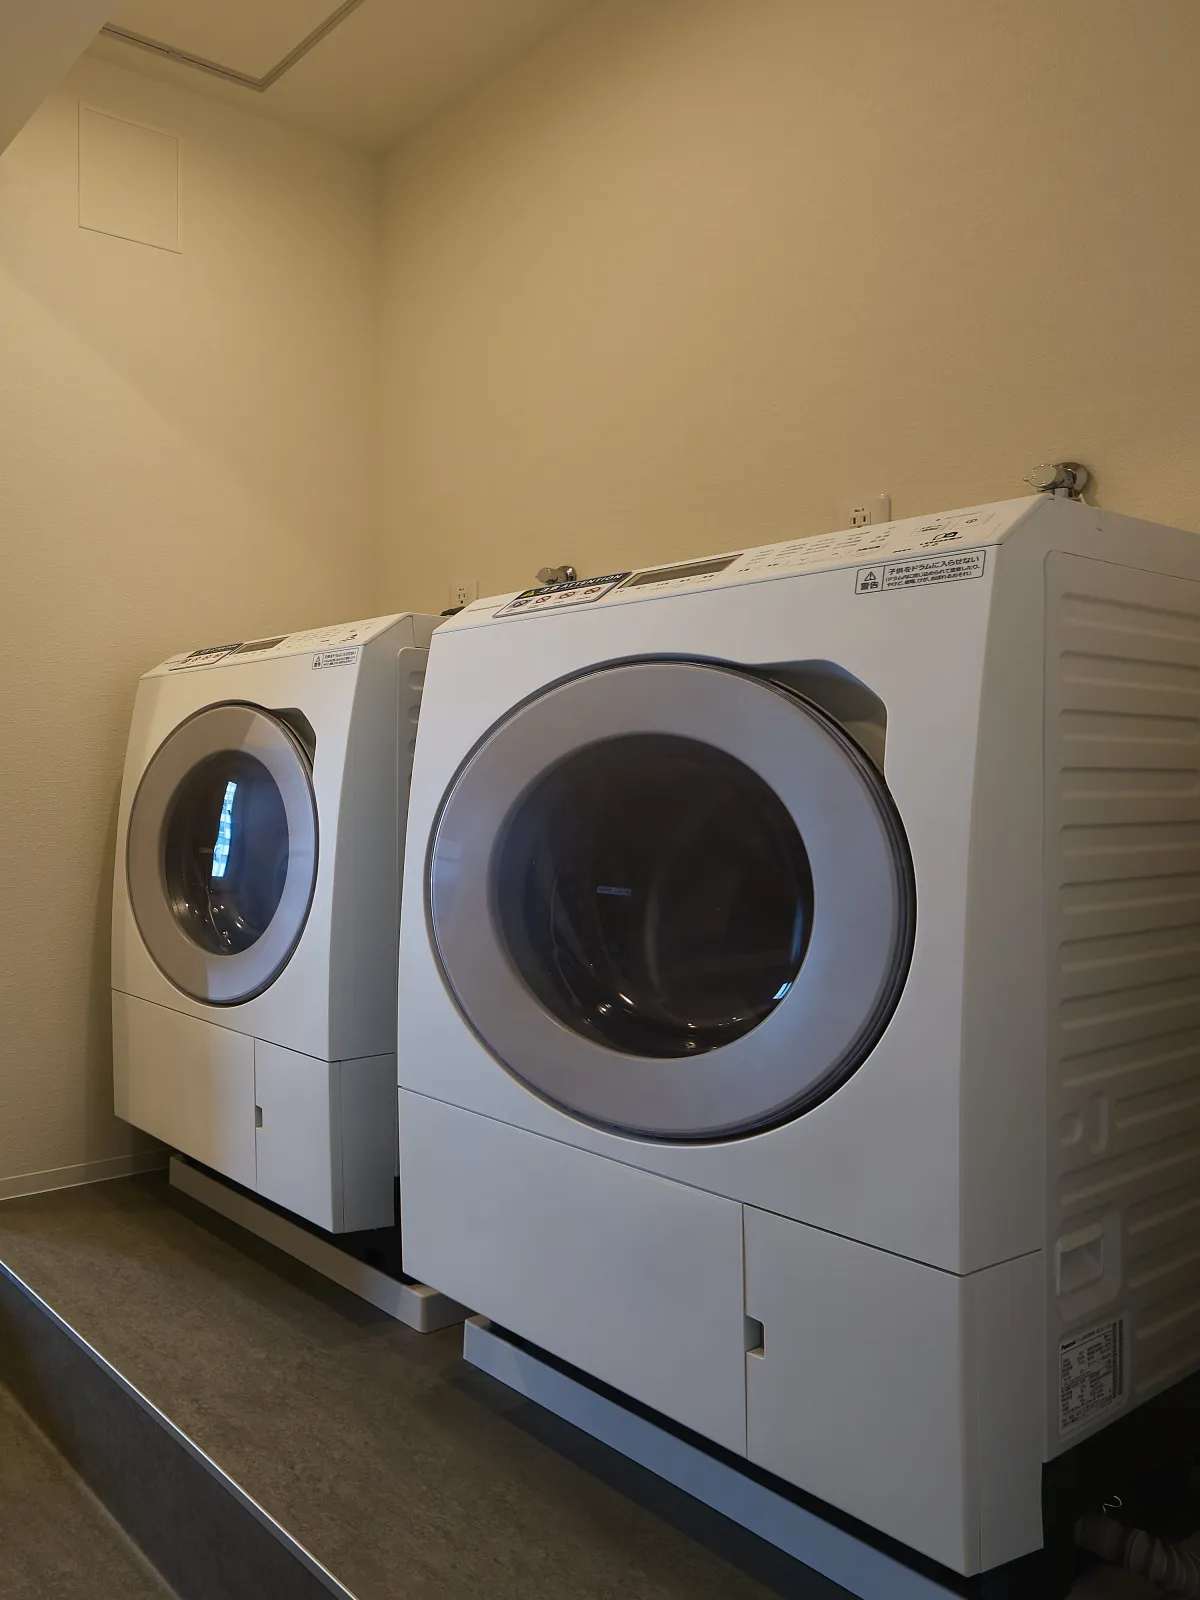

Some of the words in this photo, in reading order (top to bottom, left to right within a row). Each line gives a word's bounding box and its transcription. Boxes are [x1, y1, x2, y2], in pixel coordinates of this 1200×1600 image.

[888, 556, 980, 575] 子供をドラムに入らせない
